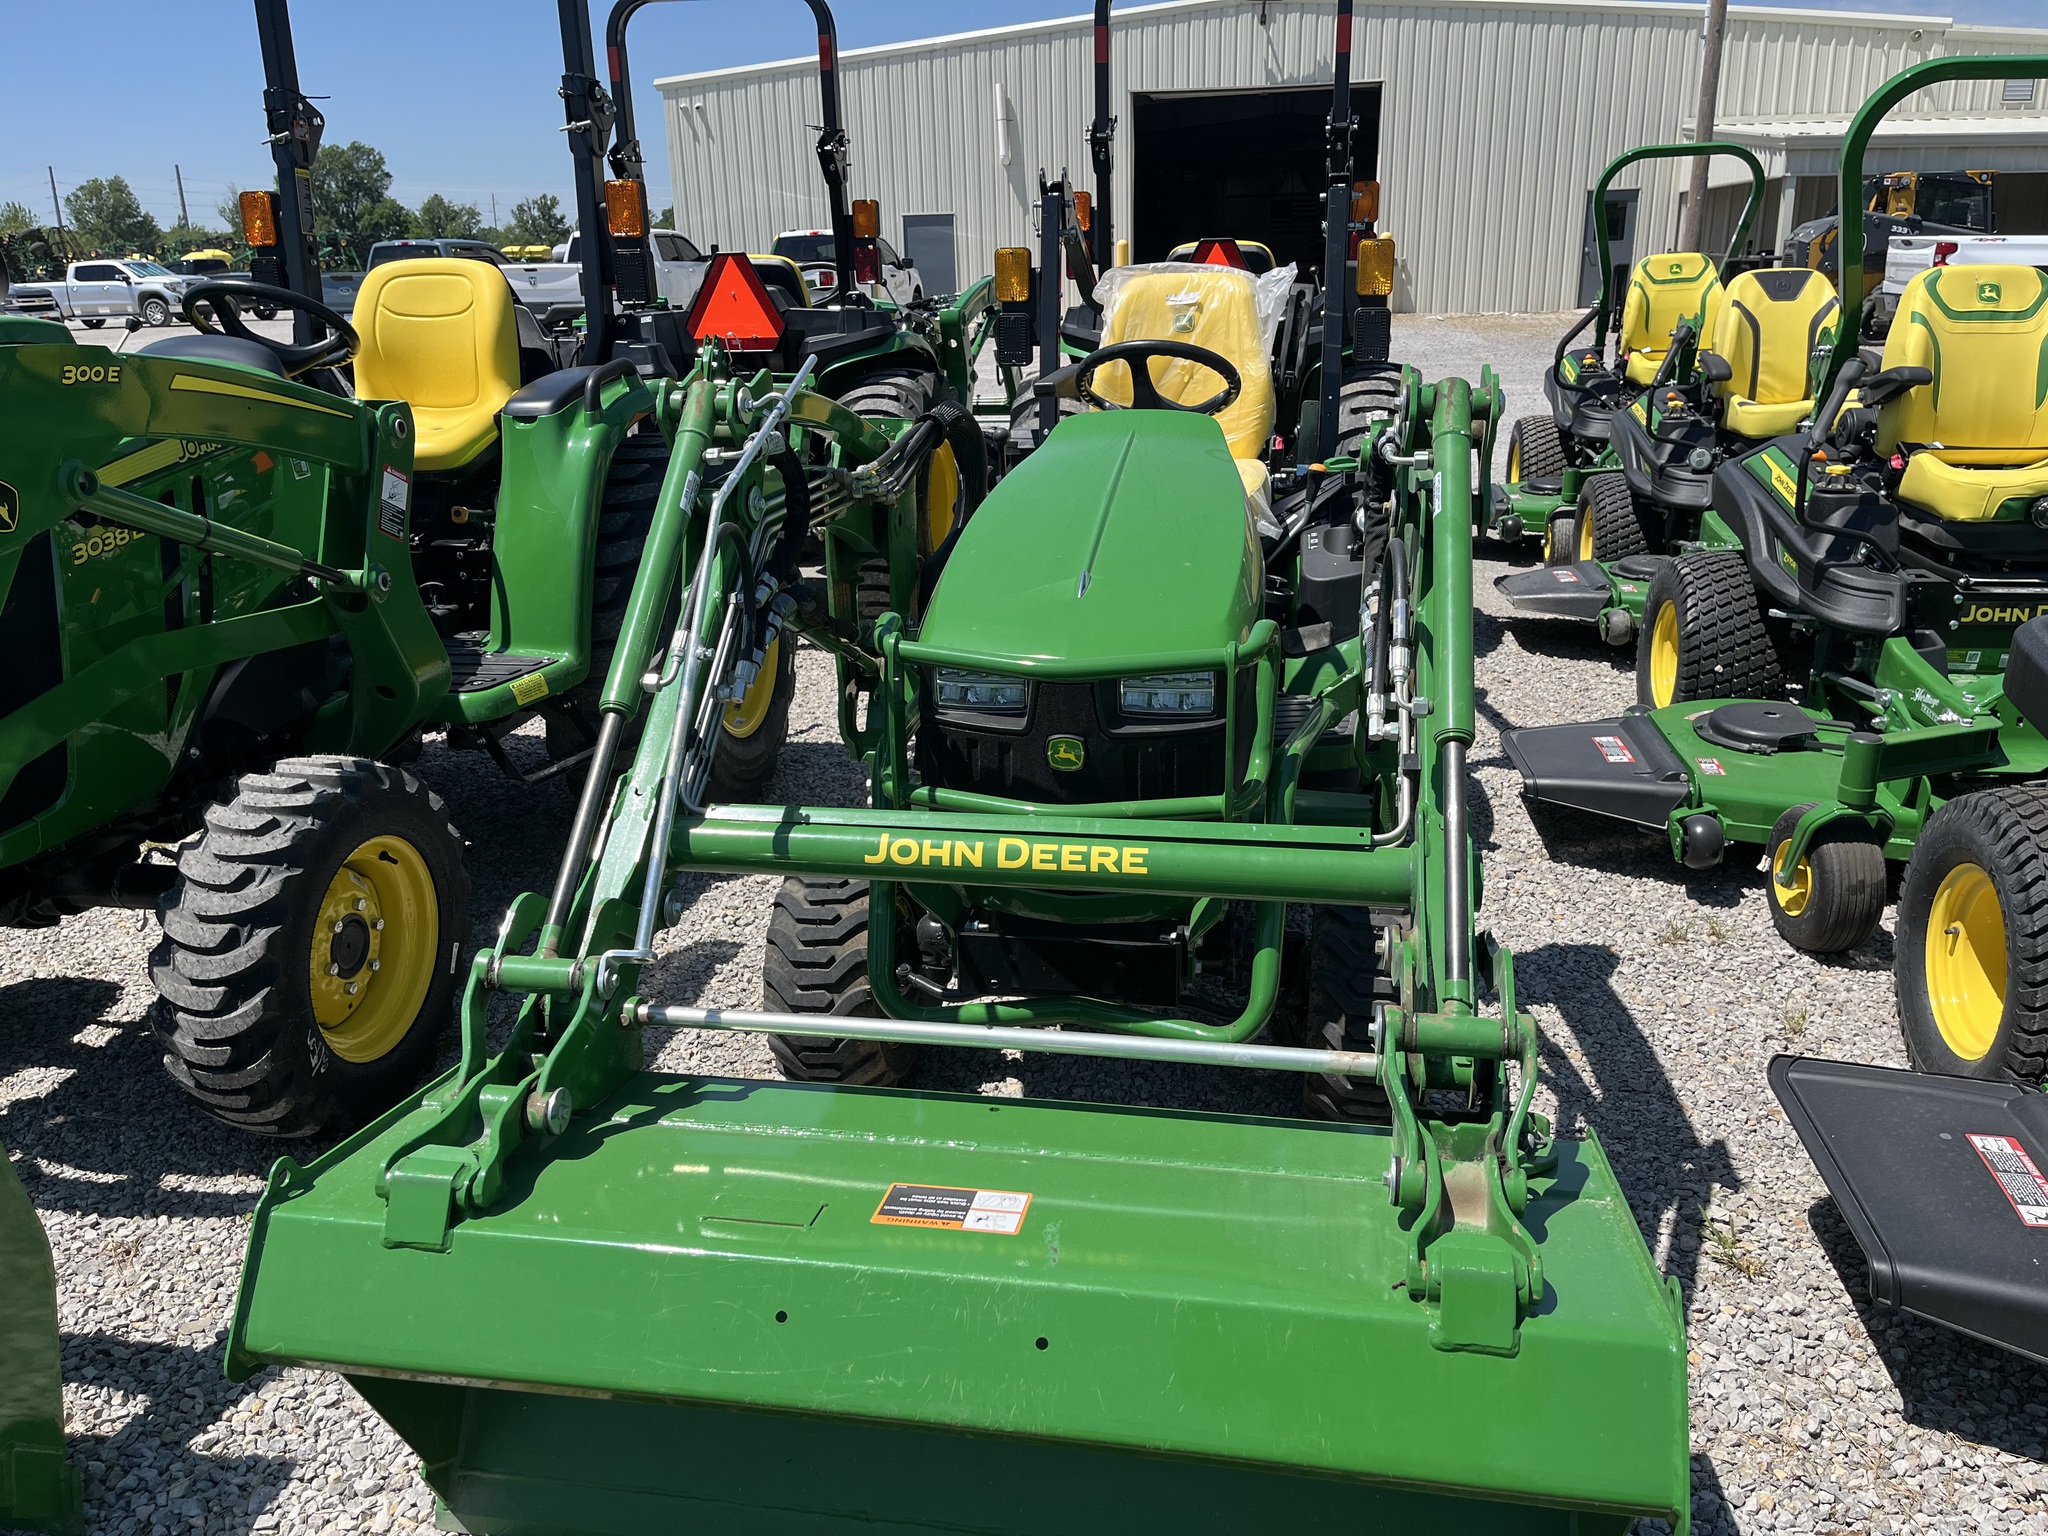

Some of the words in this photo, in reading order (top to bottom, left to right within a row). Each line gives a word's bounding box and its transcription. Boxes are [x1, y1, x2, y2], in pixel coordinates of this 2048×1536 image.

[1891, 225, 1908, 234] 333
[178, 439, 222, 464] JO
[1960, 604, 2030, 623] JOHN
[864, 833, 984, 867] JOHN
[997, 837, 1149, 874] DEERE
[886, 1217, 938, 1226] WARNING
